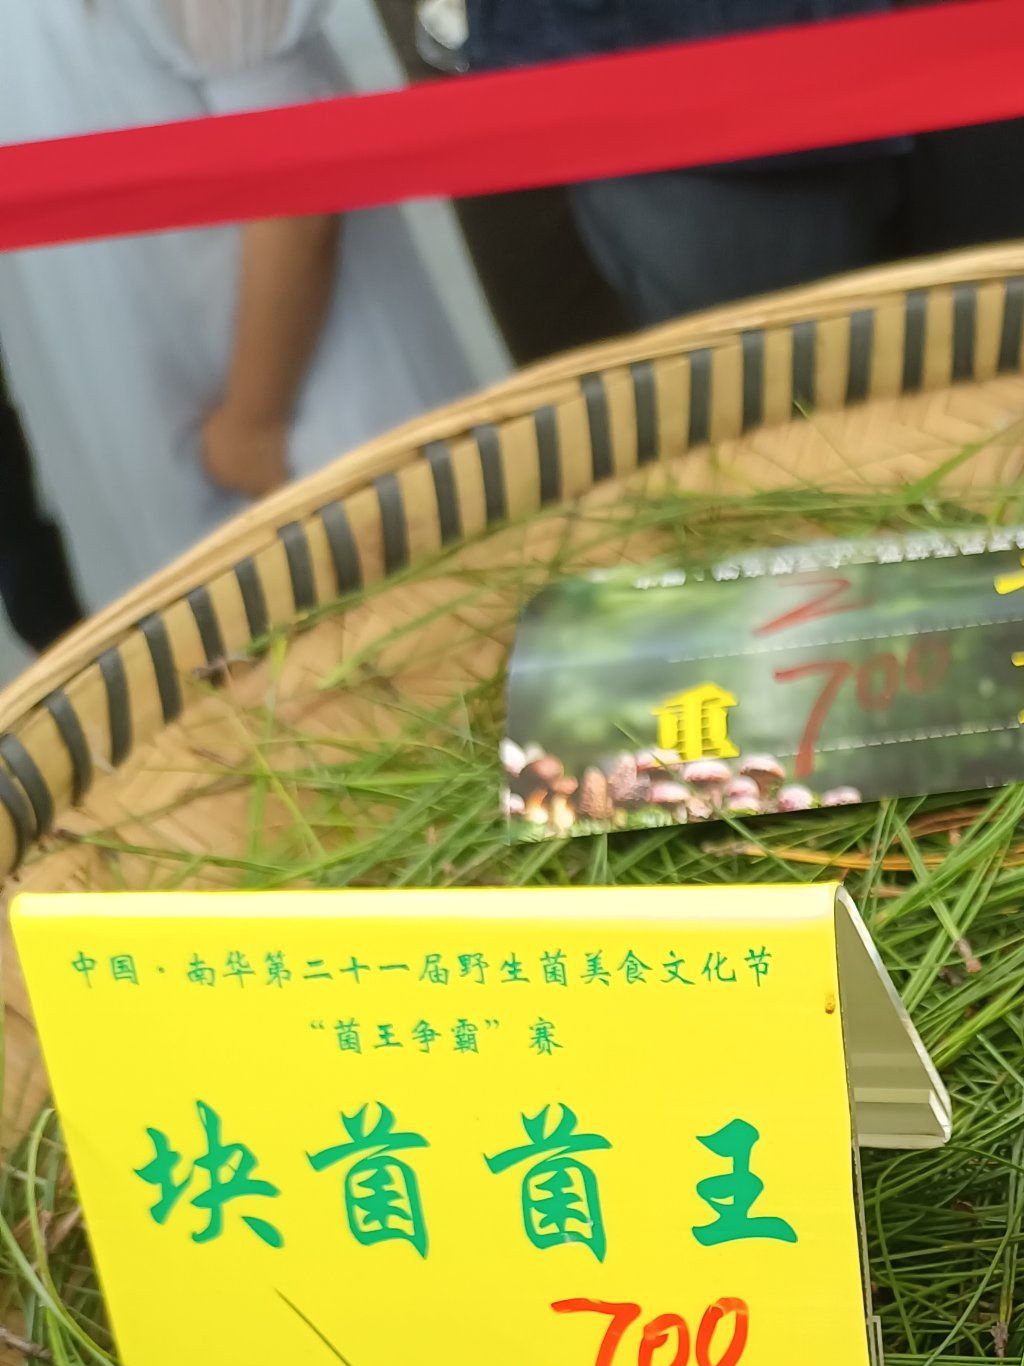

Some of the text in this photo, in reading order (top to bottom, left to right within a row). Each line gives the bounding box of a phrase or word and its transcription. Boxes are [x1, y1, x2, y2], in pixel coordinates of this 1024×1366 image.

[652, 682, 741, 766] 重
[774, 637, 952, 777] 700
[71, 946, 773, 988] 中国·南华第二十一届野生菌美食文化节
[133, 1099, 799, 1263] 块菌菌王
